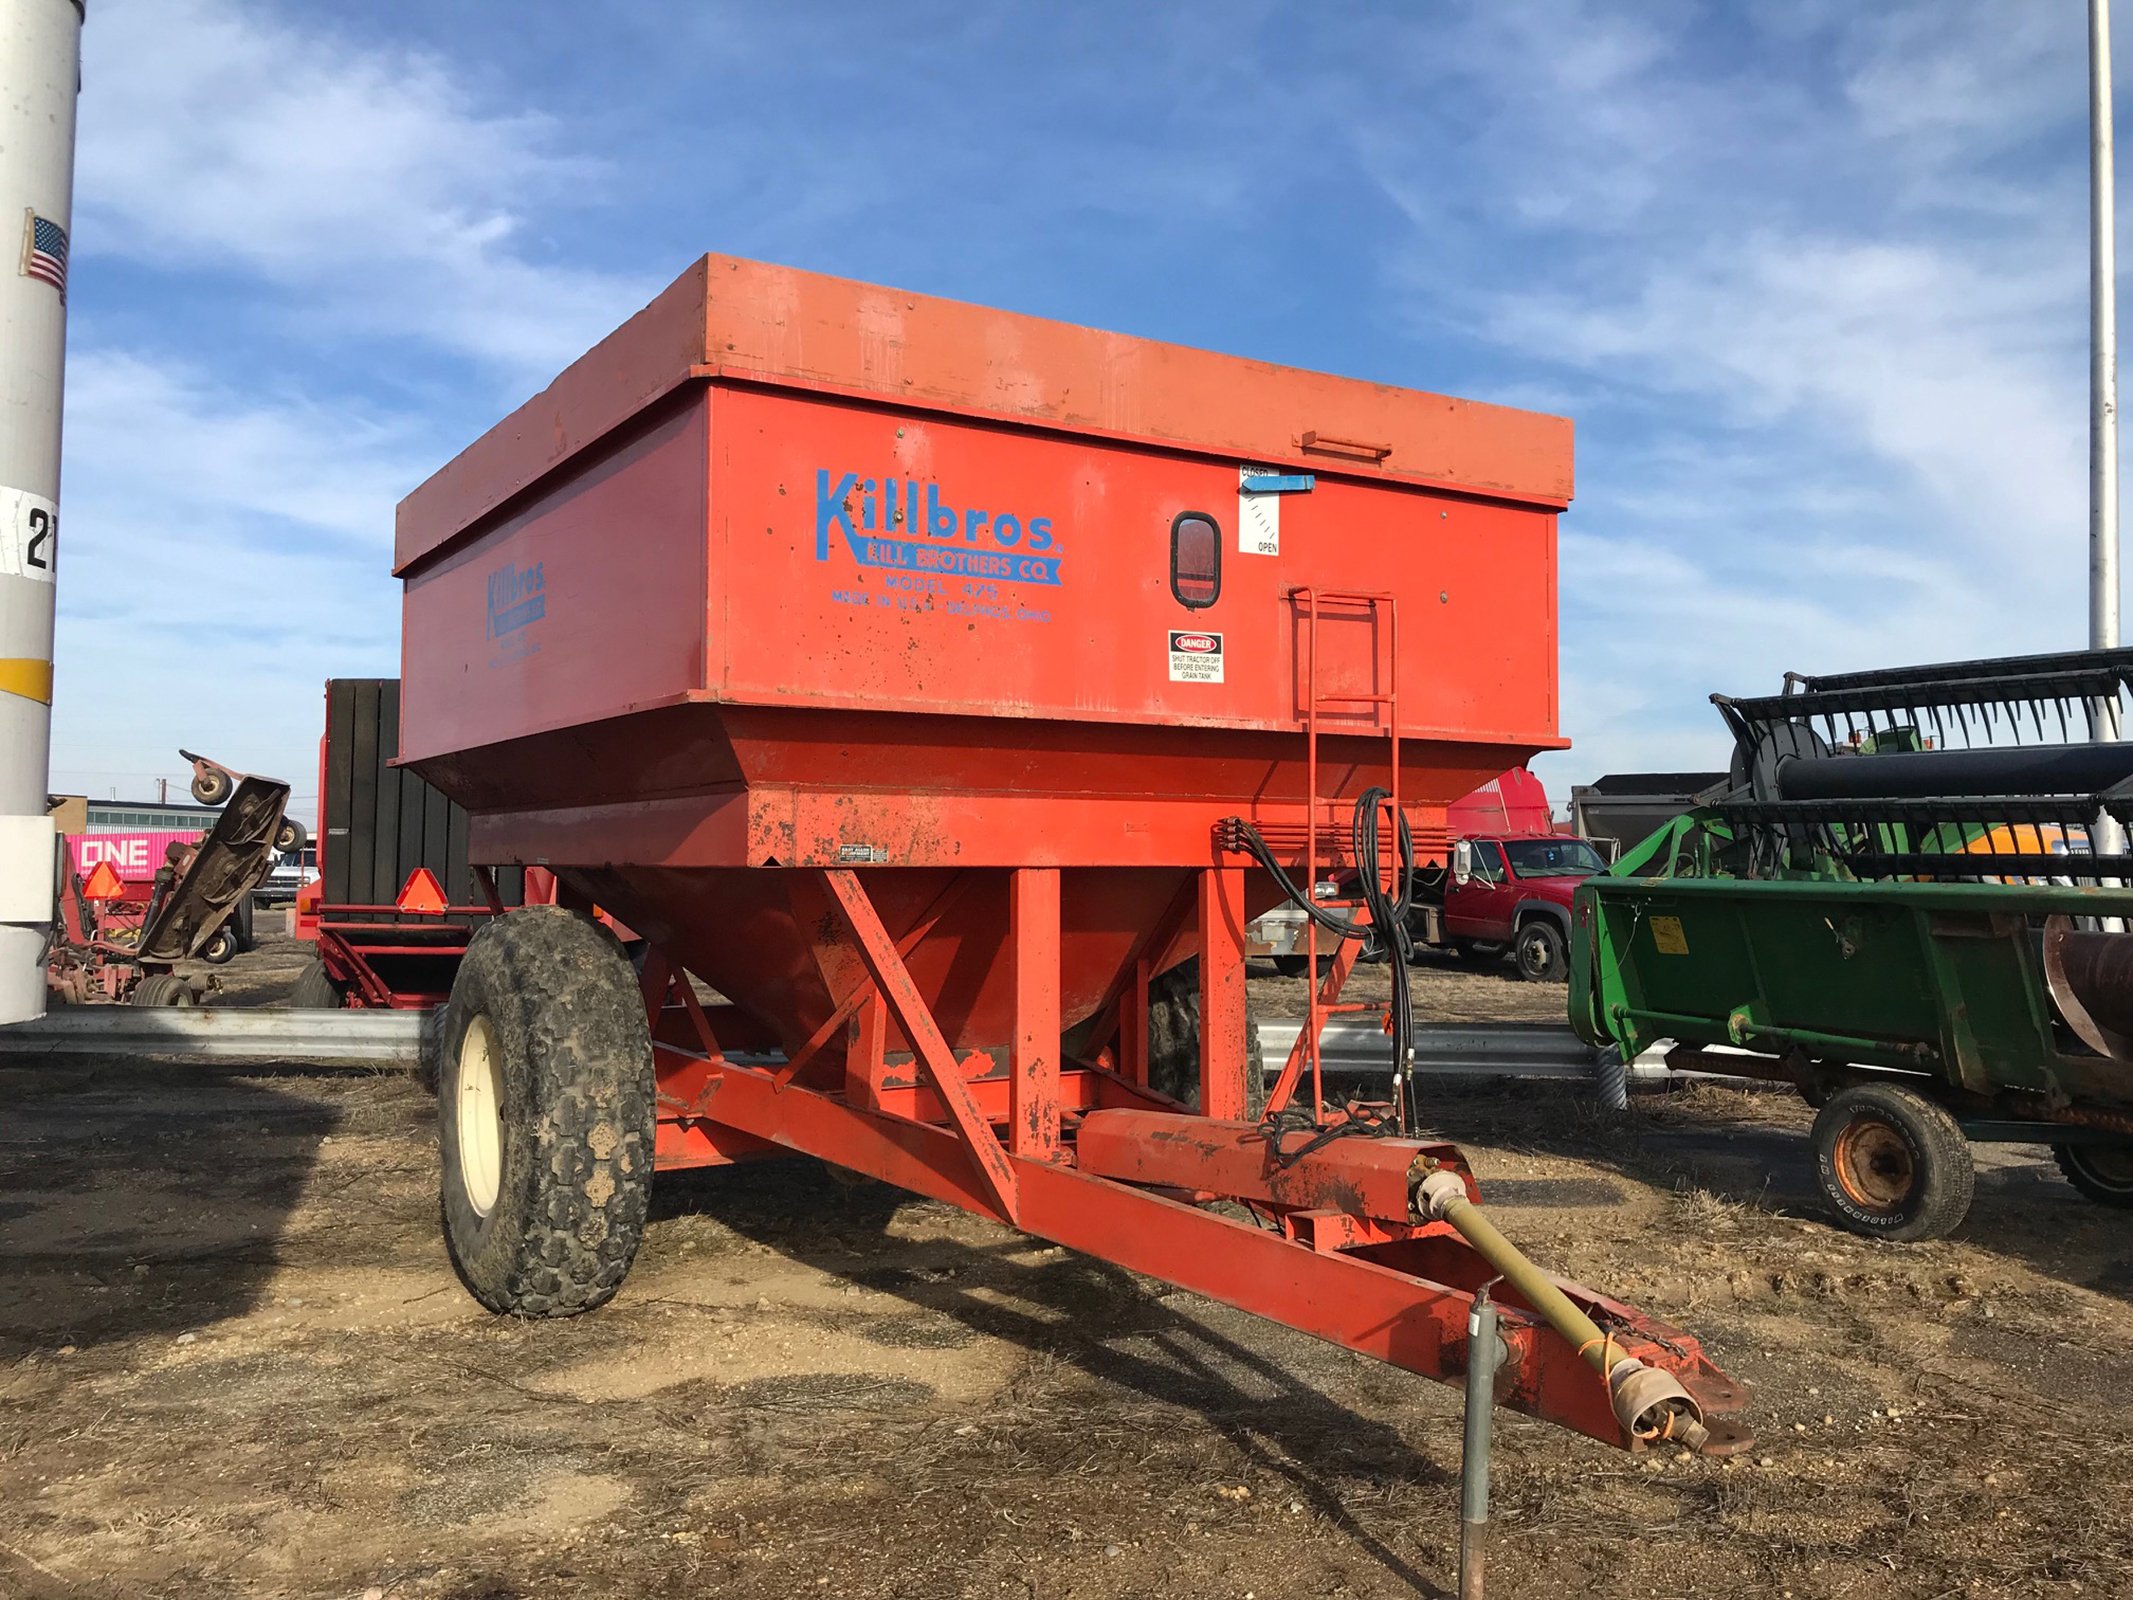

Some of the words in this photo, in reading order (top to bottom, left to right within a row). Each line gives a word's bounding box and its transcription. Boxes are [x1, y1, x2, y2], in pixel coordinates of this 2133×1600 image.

[816, 469, 1053, 562] Killbros
[1258, 541, 1277, 553] OPEN
[867, 541, 907, 566] KILL
[915, 548, 1012, 577] BROTHERS
[885, 575, 947, 596] MODEL
[961, 583, 999, 601] 475
[831, 589, 870, 606] MADE
[876, 593, 891, 608] IN
[1016, 608, 1051, 623] OHIO
[1181, 638, 1212, 649] DANGER
[1172, 654, 1185, 662] SHUT
[1187, 655, 1210, 664] TRACTOR
[1211, 656, 1220, 664] OFF
[1174, 662, 1194, 671] BEFORE
[1195, 663, 1219, 672] ENTERING
[1182, 671, 1198, 679] GRAIN
[1199, 672, 1212, 680] TANK
[81, 840, 147, 867] ONE
